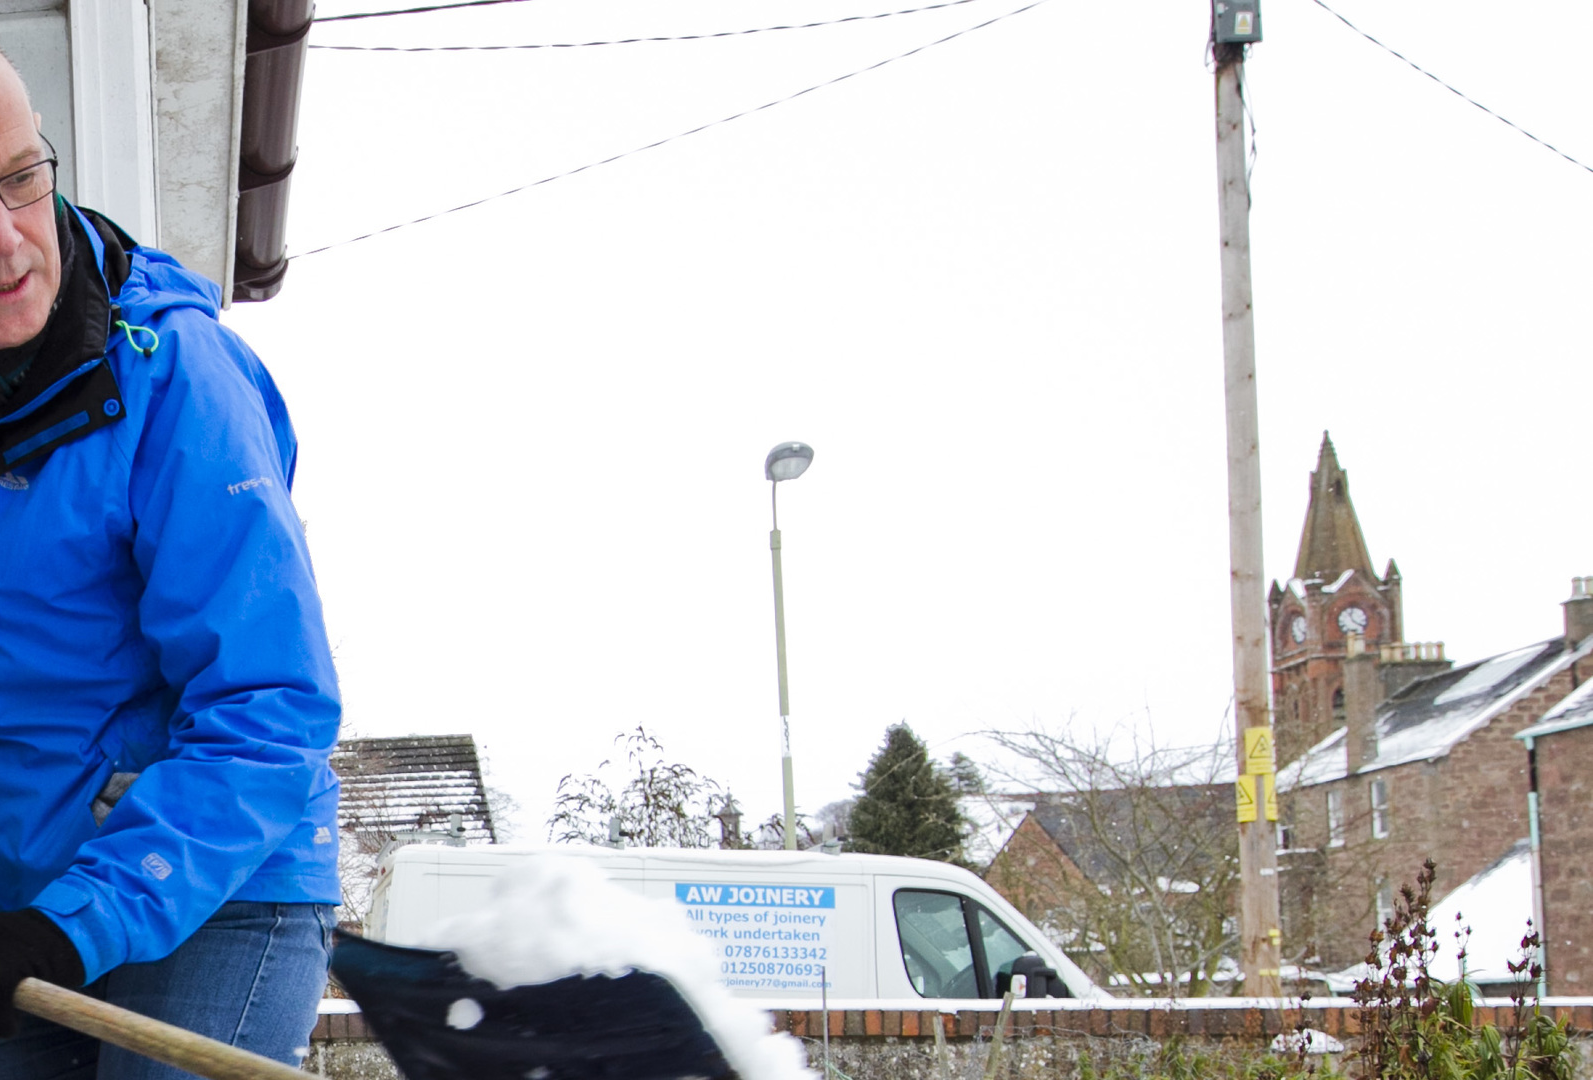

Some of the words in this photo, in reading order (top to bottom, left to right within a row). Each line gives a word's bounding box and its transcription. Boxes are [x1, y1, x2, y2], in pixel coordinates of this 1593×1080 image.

[686, 886, 722, 903] AW
[728, 887, 824, 906] JOINERY
[686, 909, 704, 922] All
[708, 910, 749, 924] types
[754, 911, 769, 923] of
[772, 912, 826, 927] joinery
[734, 929, 820, 941] undertaken
[725, 945, 827, 960] 07876133342
[721, 962, 823, 976] 01250870693
